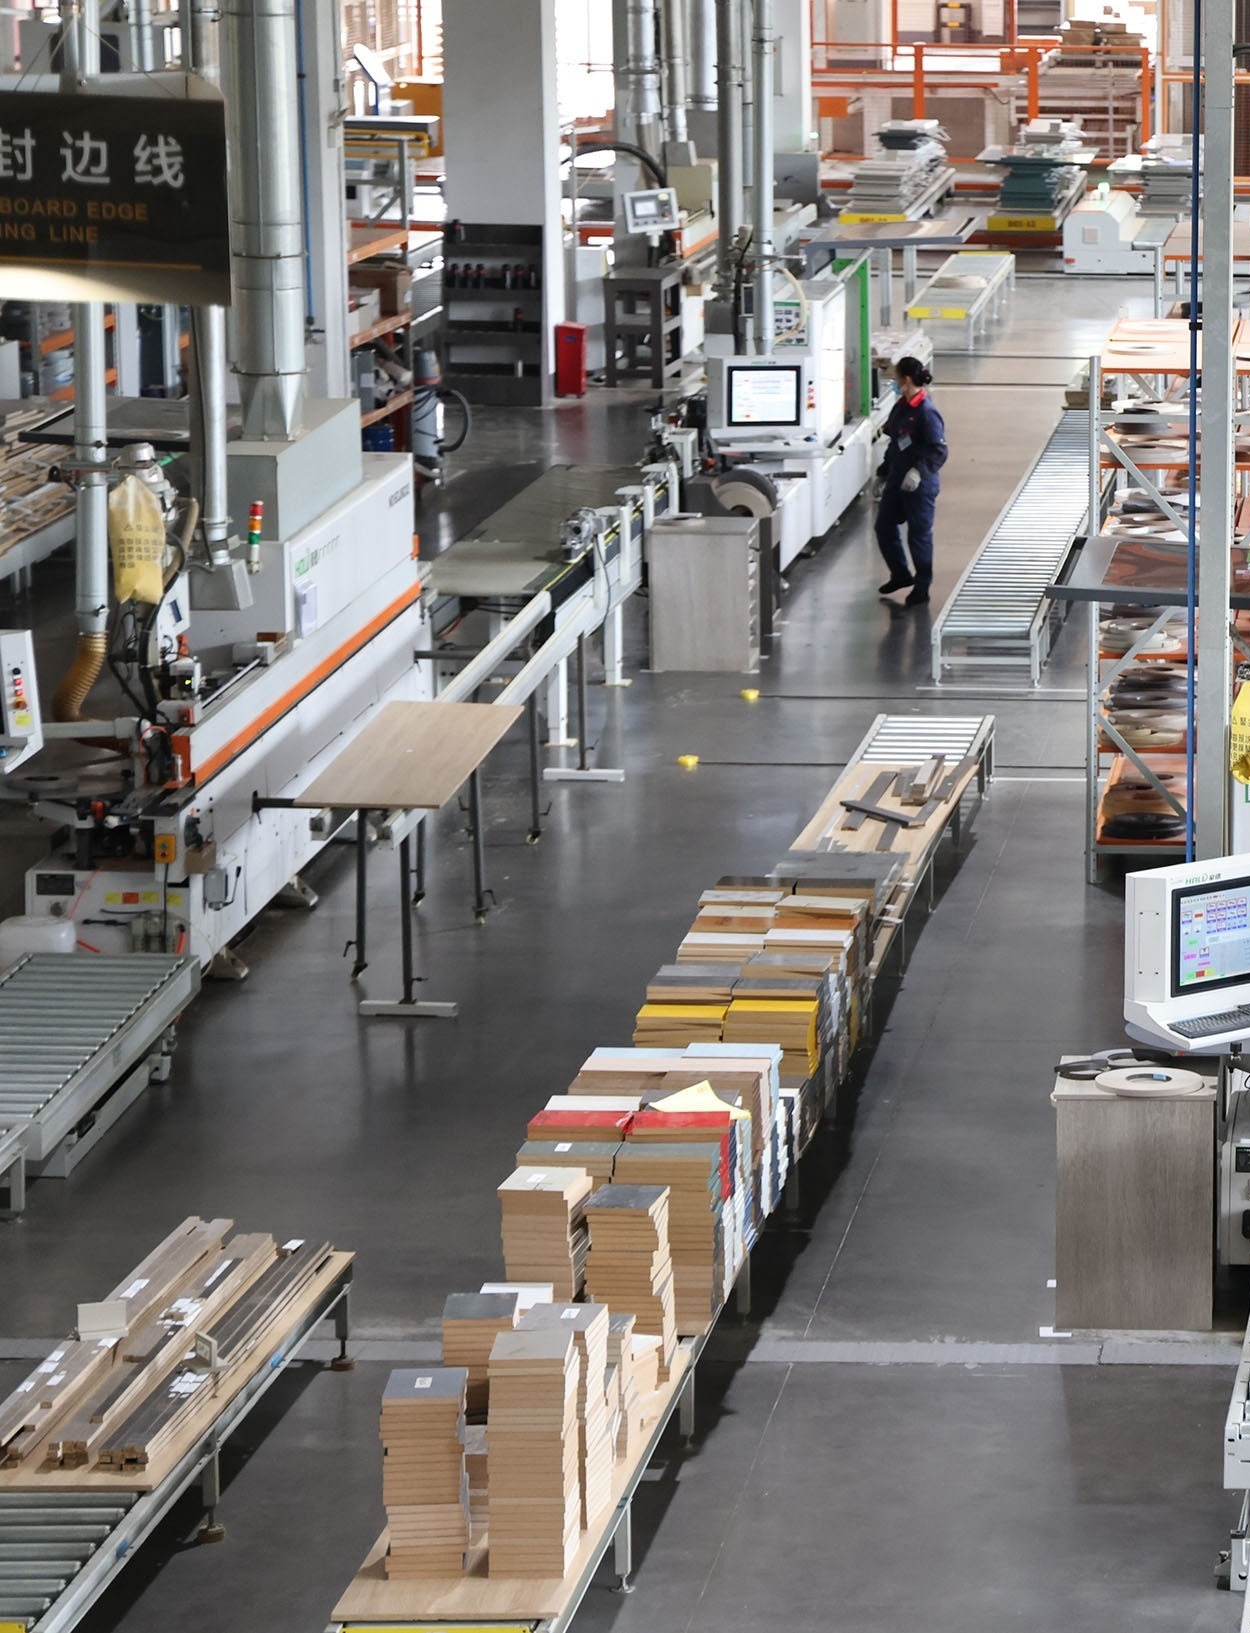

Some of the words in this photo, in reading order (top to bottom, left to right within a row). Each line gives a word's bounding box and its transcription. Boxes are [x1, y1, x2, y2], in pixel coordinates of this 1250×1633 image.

[0, 128, 185, 188] 封边线
[0, 196, 78, 218] BOARD
[87, 201, 149, 221] EDGE
[50, 225, 100, 244] LINE
